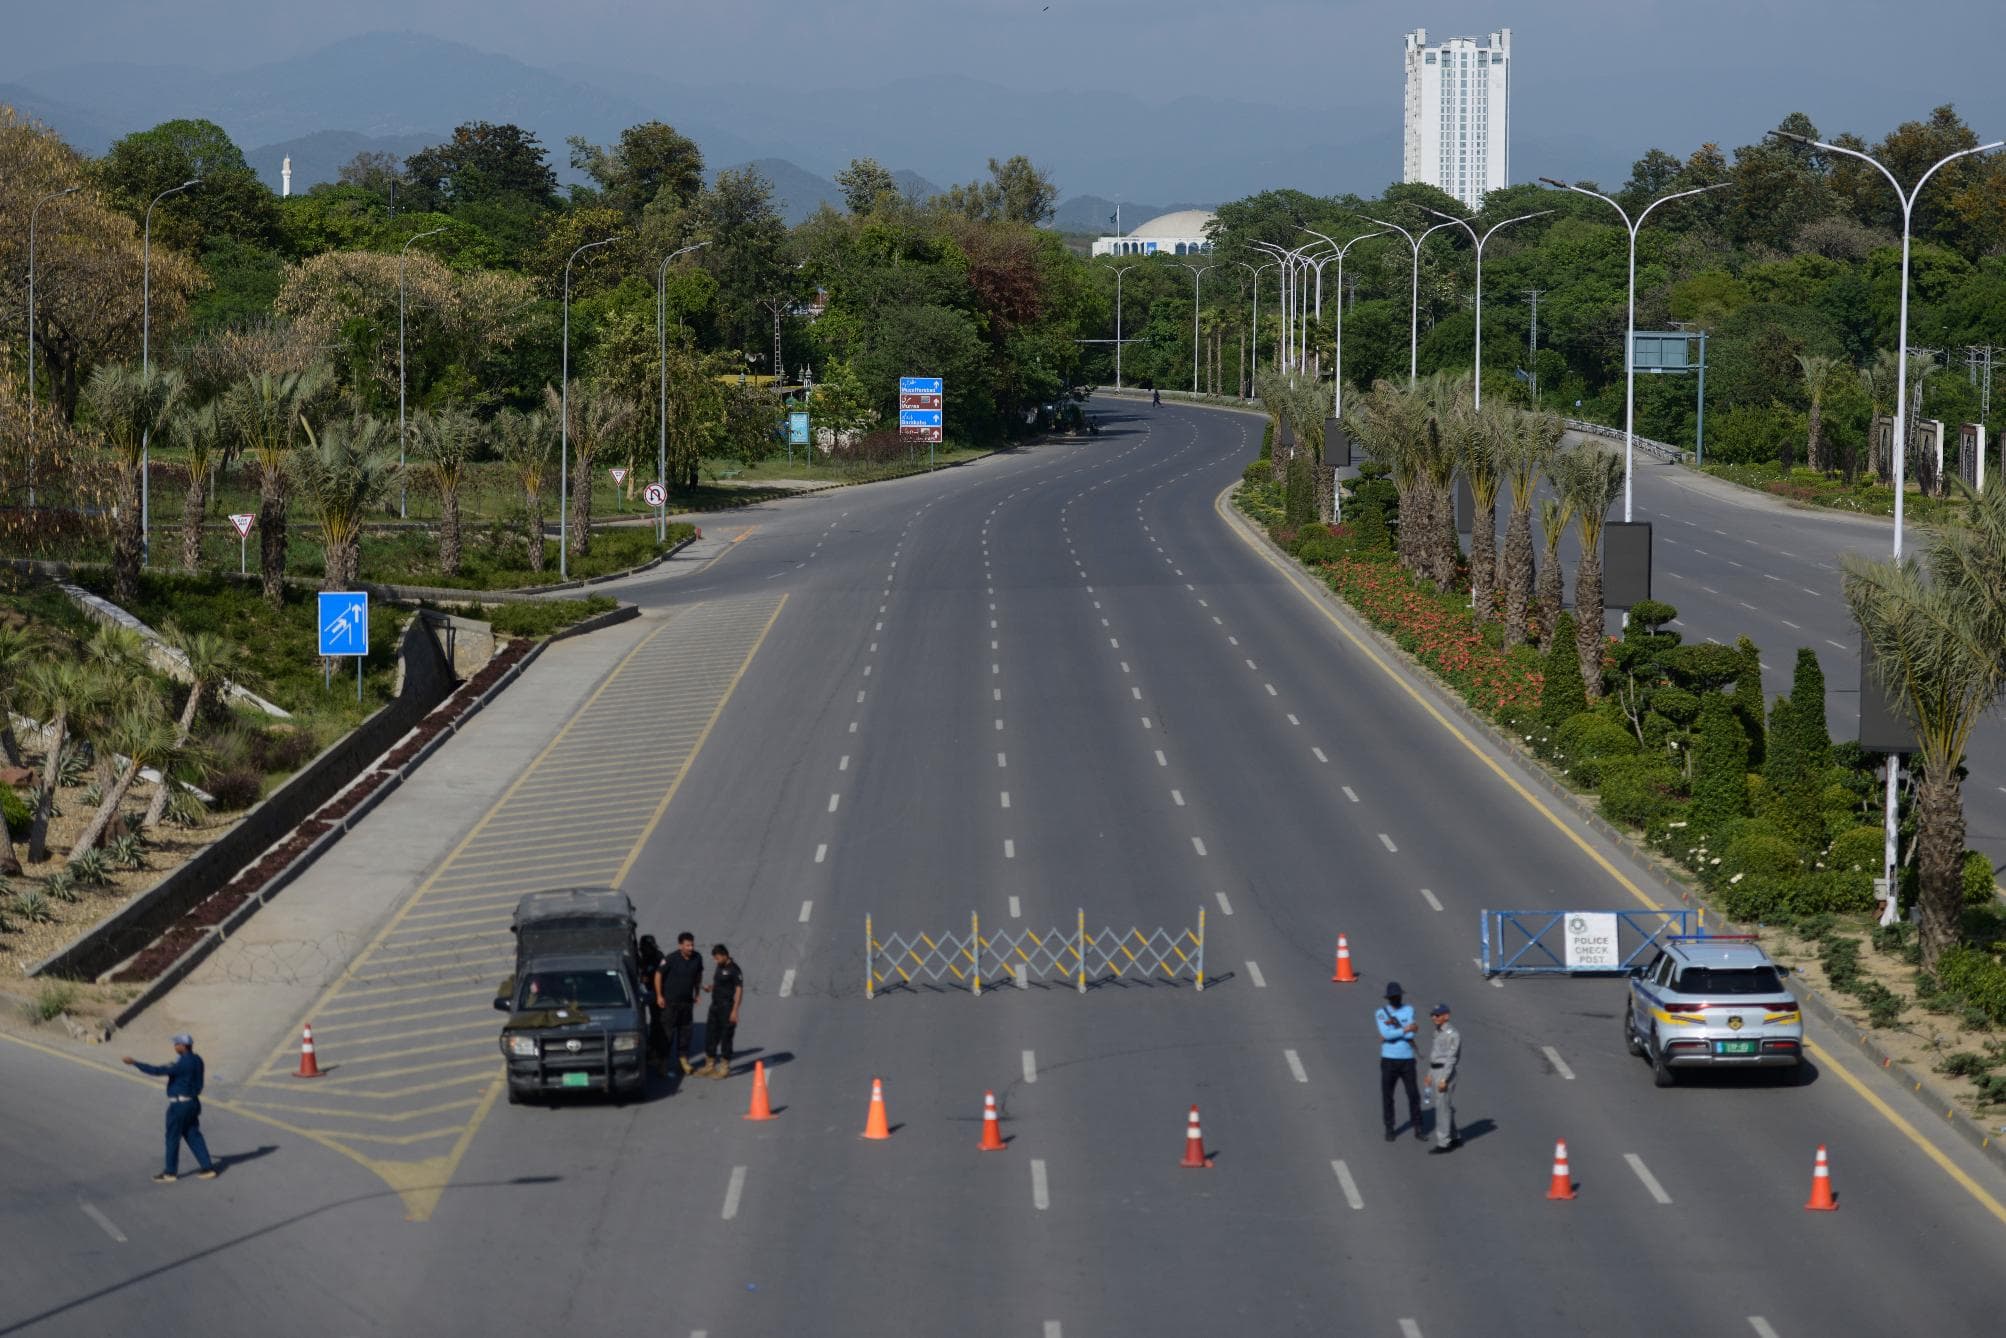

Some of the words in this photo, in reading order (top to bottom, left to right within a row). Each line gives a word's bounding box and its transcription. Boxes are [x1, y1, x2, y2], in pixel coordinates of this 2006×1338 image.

[1574, 937, 1609, 945] POLICE
[1575, 946, 1609, 954] CHECK
[1580, 955, 1606, 963] POST
